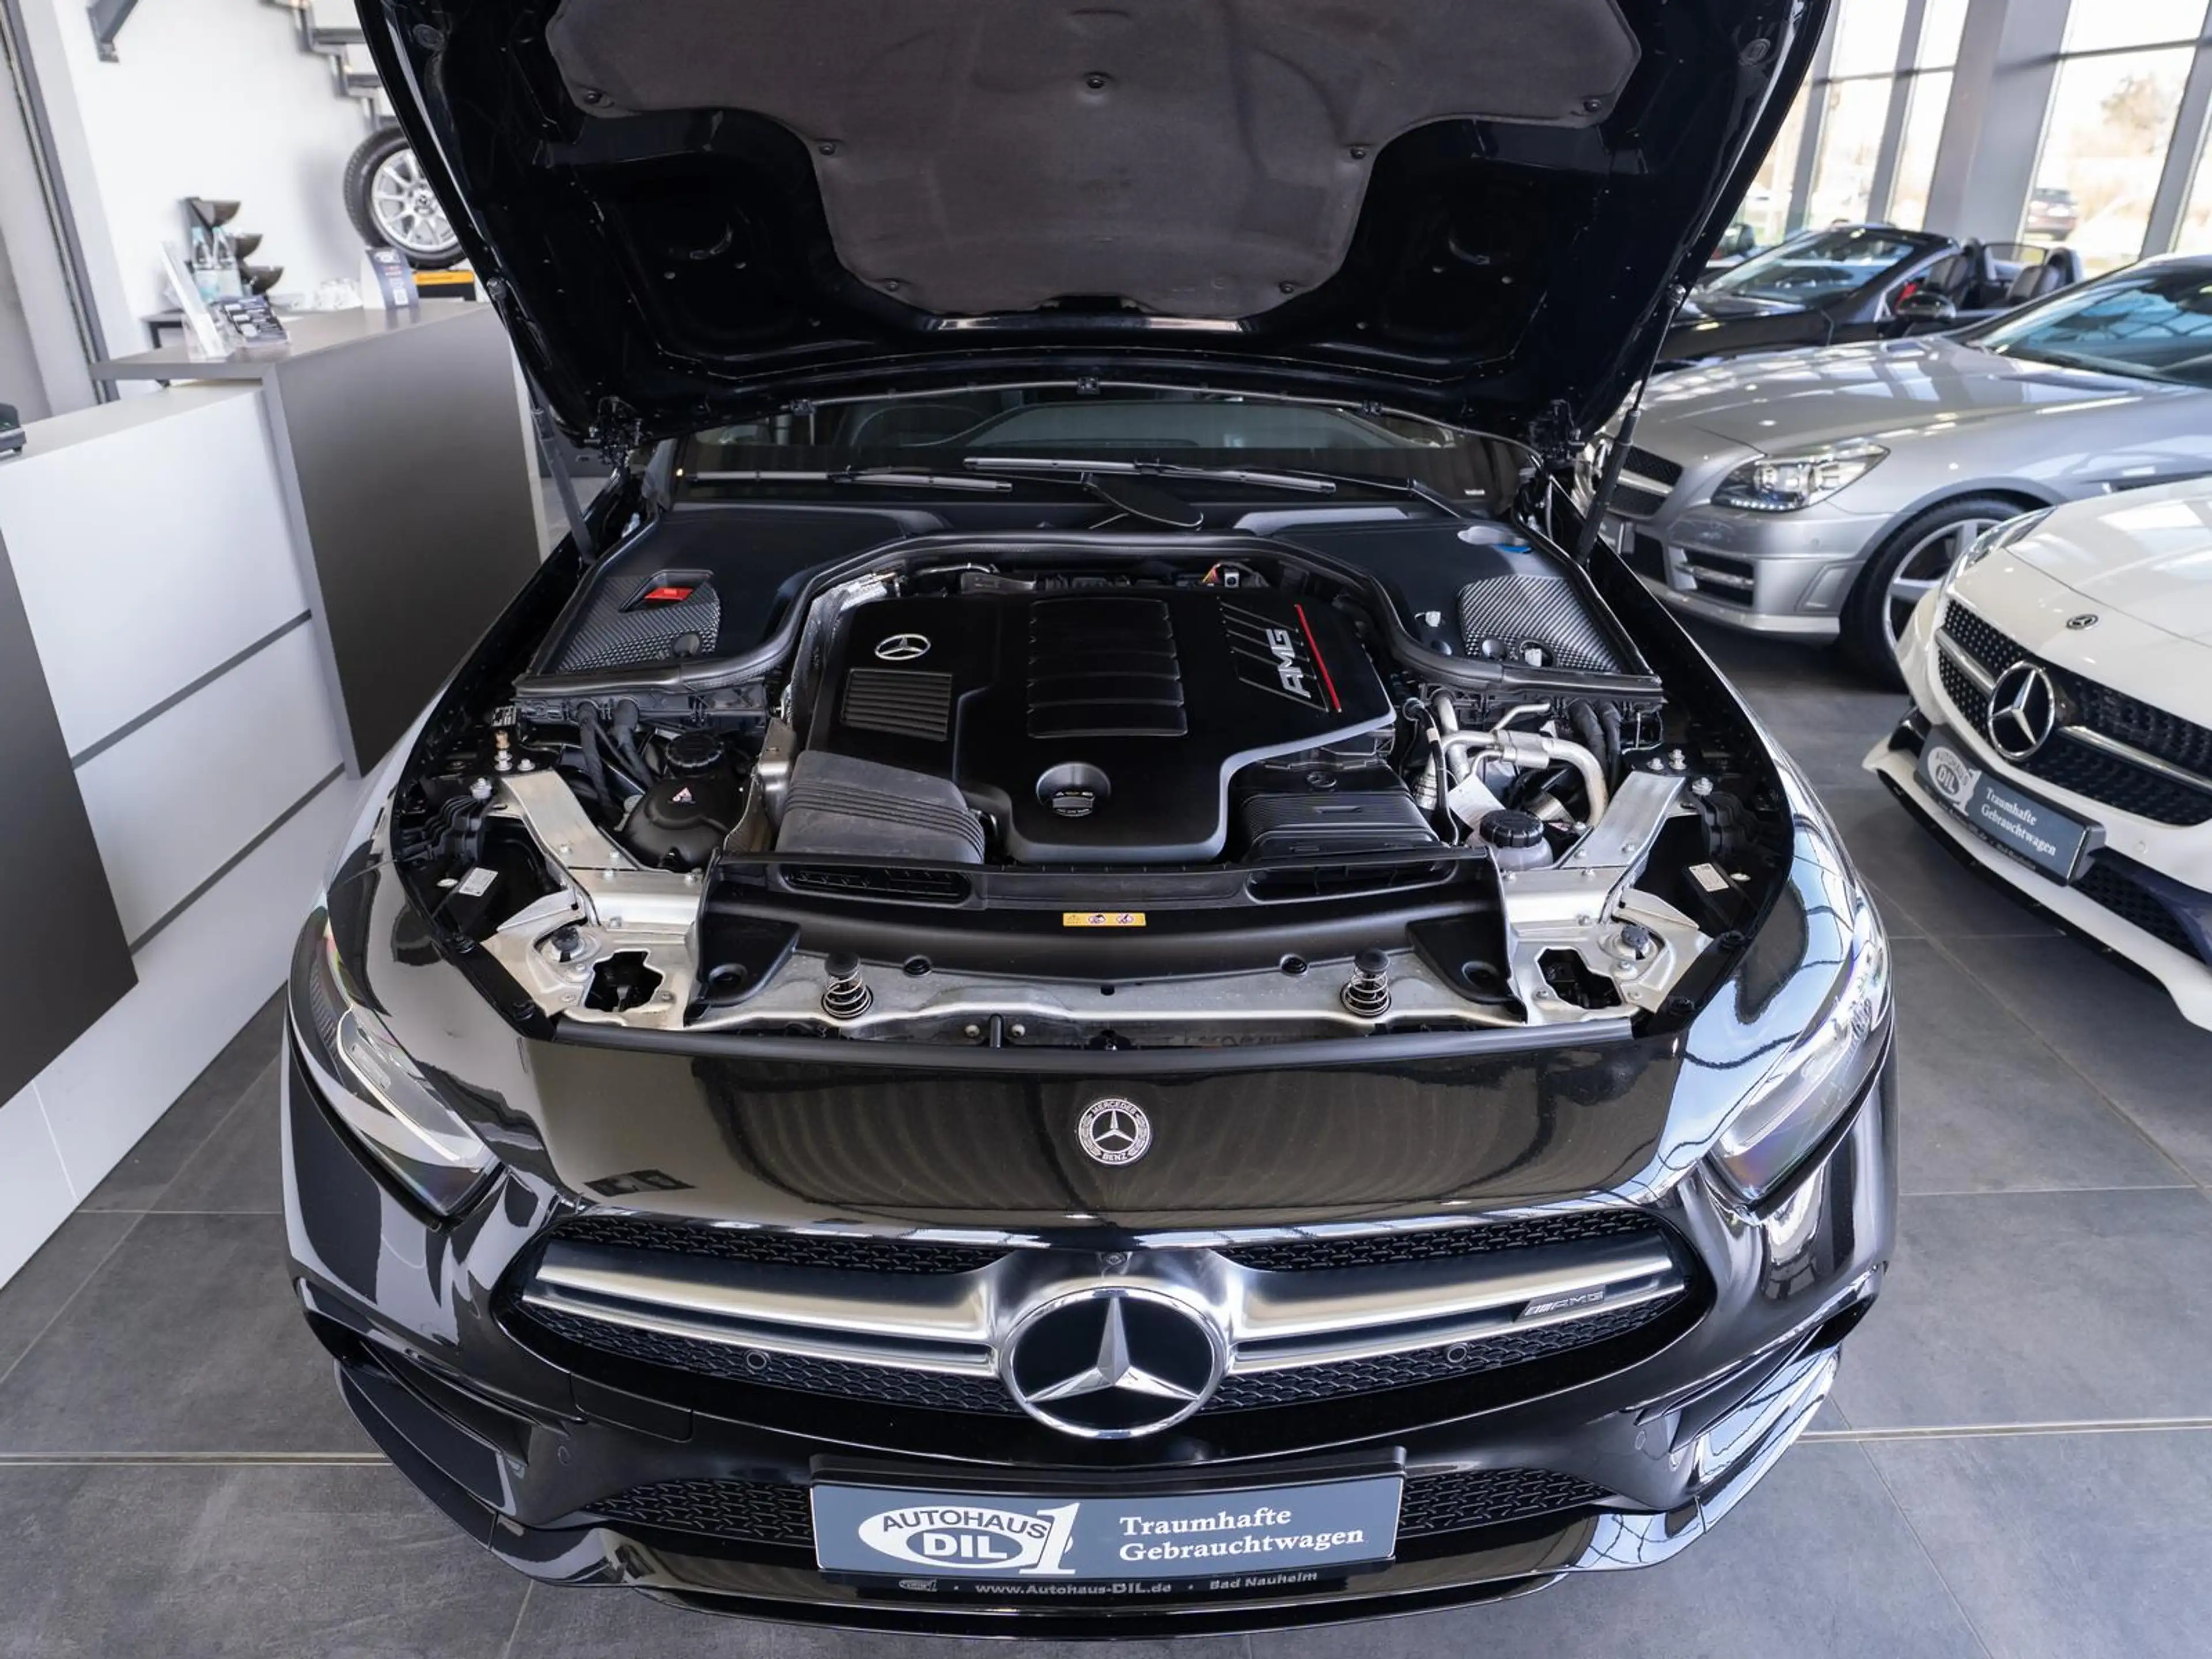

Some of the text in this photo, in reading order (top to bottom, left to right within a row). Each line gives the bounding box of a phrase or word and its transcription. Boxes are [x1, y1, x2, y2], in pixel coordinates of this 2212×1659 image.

[1266, 628, 1312, 699] AMG
[1937, 766, 1955, 793] DIL
[1986, 787, 2037, 826] Traumhafte
[1981, 804, 2056, 856] Gebrauchtwagen
[882, 1509, 1048, 1539] AUTOHAUS
[1119, 1507, 1292, 1536] Traumhafte
[923, 1502, 1081, 1575] DIL 1
[1119, 1529, 1365, 1561] Gebrauchtwagen
[975, 1571, 1318, 1595] www.Autohaus-DIL.de Bad Nauheim
